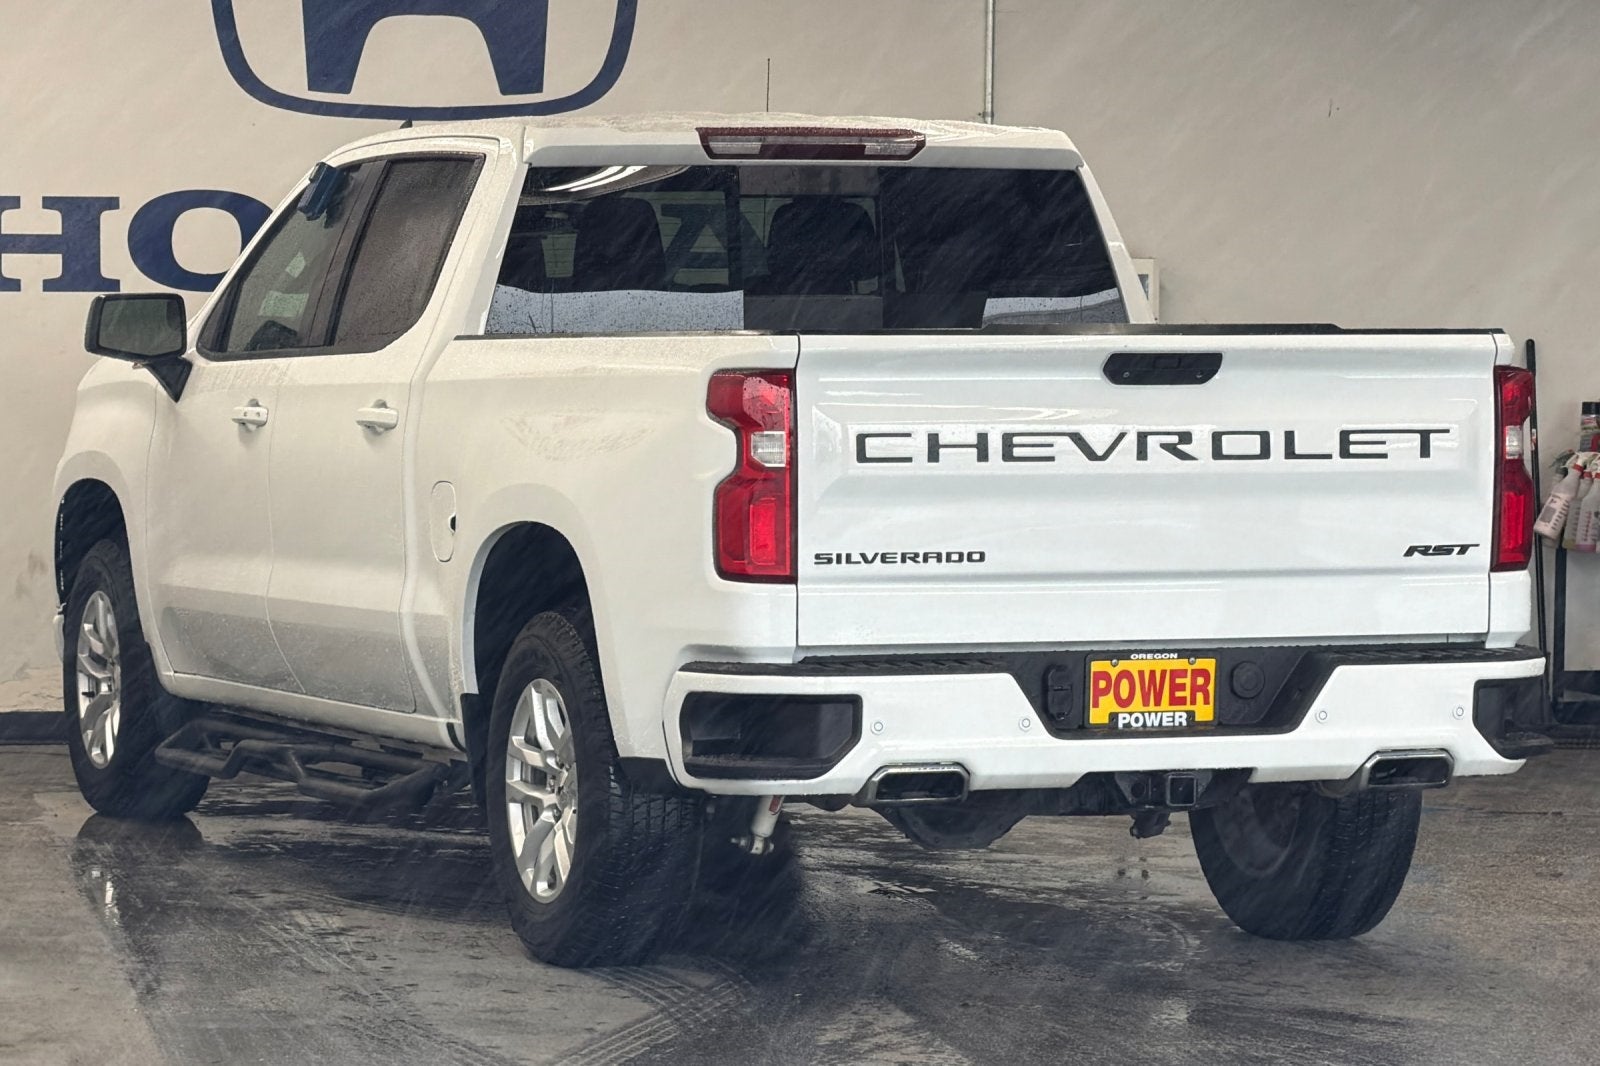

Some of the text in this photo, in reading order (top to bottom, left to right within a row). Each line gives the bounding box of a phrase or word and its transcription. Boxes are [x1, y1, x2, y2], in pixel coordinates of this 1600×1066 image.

[856, 428, 1450, 463] CHEVROLET
[813, 550, 986, 565] SILVERADO
[1403, 543, 1480, 558] RST
[1091, 668, 1211, 709] POWER
[1117, 711, 1187, 729] POWER
